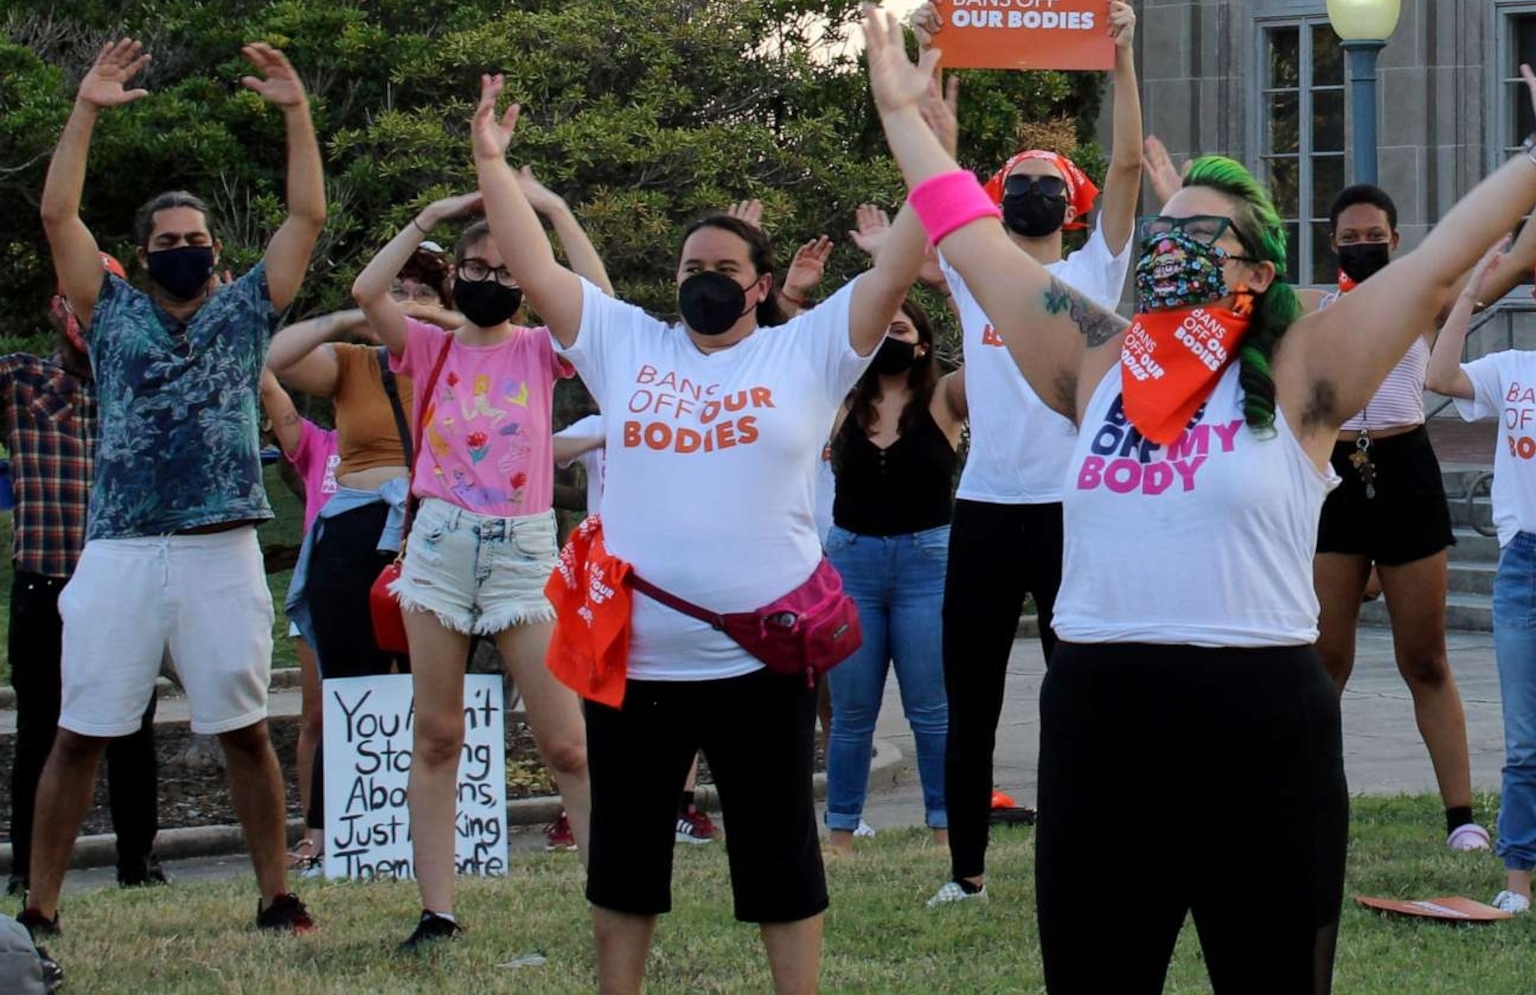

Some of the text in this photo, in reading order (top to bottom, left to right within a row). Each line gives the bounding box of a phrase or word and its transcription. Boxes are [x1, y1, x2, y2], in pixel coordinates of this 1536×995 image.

[952, 10, 1095, 29] OUR BODIES
[1132, 322, 1156, 353] BANS
[1183, 317, 1210, 340] OFF
[1192, 308, 1226, 339] BANS
[1121, 349, 1149, 381] ODIES
[1125, 334, 1165, 380] OFF OUR
[1174, 327, 1220, 371] BODIES
[628, 387, 776, 424] OFF OUR
[624, 415, 759, 453] BODIES
[1167, 420, 1243, 461] MY
[1077, 456, 1208, 495] BODY
[334, 689, 399, 742] You
[334, 814, 404, 849] Just
